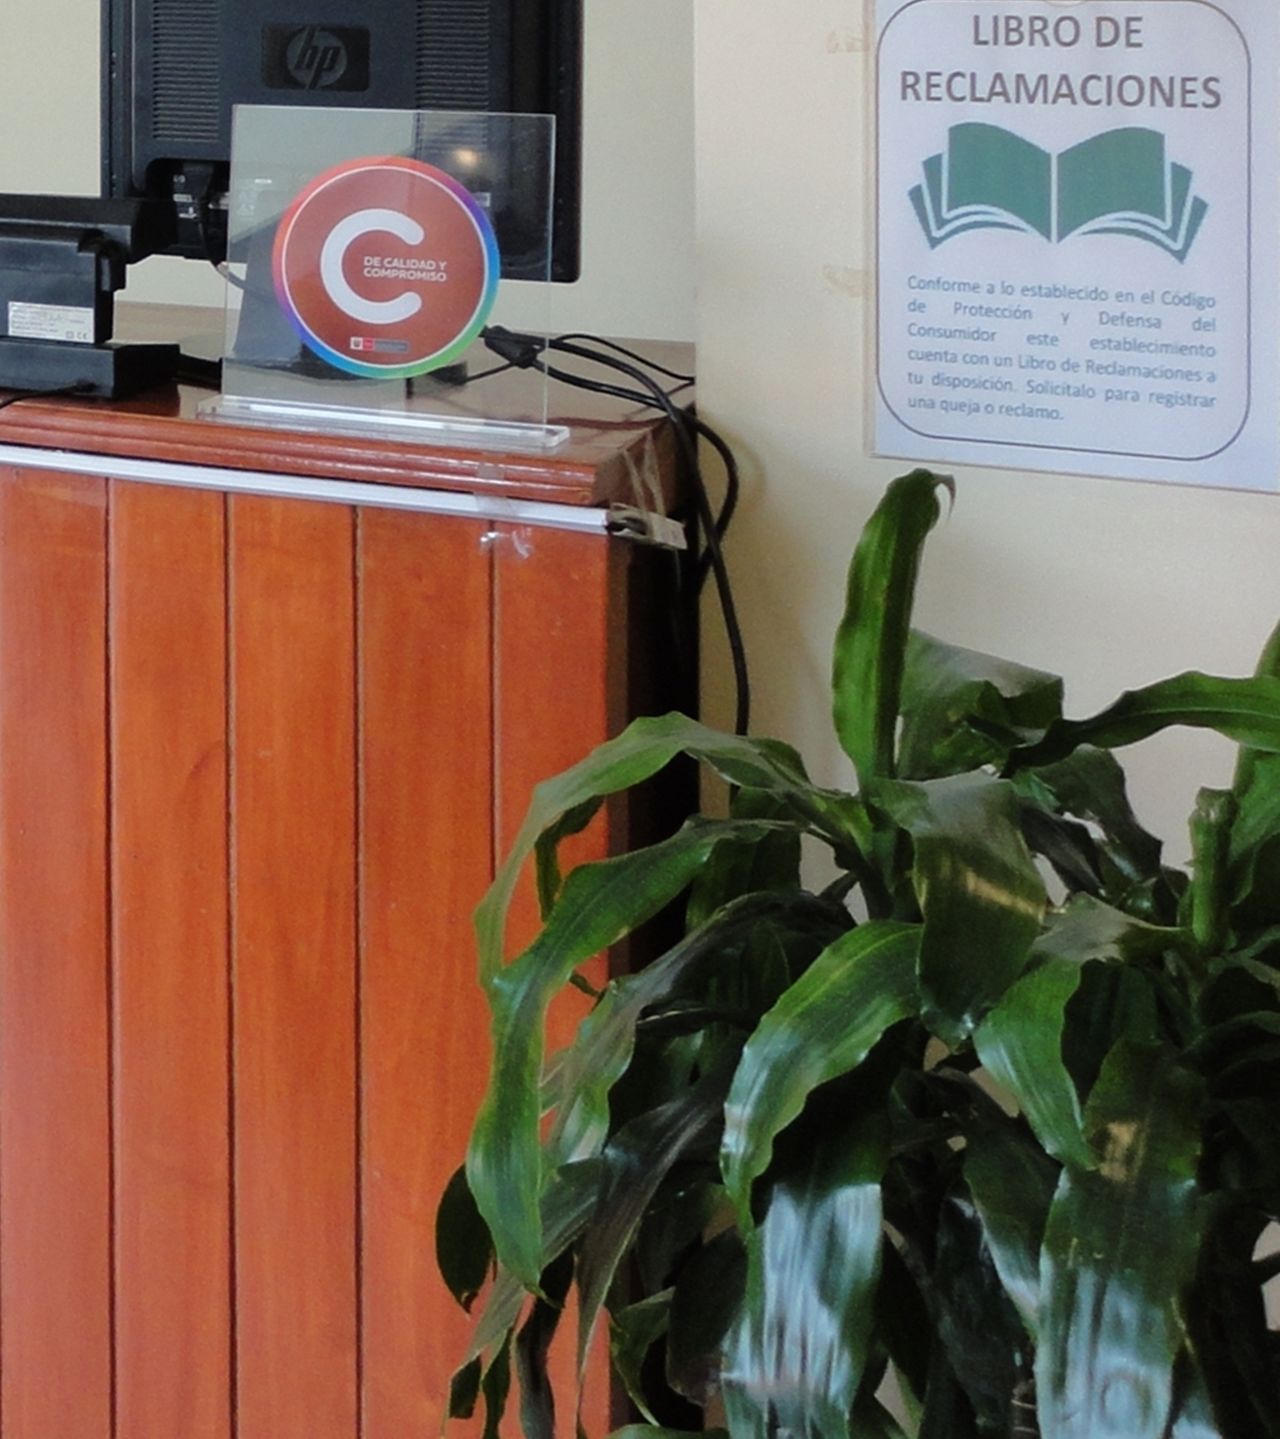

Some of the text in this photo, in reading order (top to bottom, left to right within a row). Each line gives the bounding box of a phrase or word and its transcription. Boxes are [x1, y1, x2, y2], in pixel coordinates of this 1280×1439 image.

[972, 15, 1144, 48] LIBRO DE
[293, 27, 342, 89] hp
[899, 70, 1222, 109] RECLAMACIONES
[320, 208, 425, 325] C
[363, 256, 448, 271] DE CALIDAD Y
[363, 267, 447, 282] COMPROMISO
[907, 275, 981, 294] Conforme
[986, 282, 996, 295] a
[1000, 281, 1015, 296] lo
[1020, 282, 1109, 303] establecido
[1114, 290, 1134, 303] en
[1141, 289, 1155, 304] el
[907, 299, 1217, 332] de Protección y Defensa del
[907, 322, 1217, 358] Consumidor este establecimiento
[907, 349, 1217, 383] cuenta con un Libro de Reclamaciones a
[907, 372, 924, 385] tu
[1104, 388, 1141, 404] para
[1148, 391, 1217, 409] registrar
[907, 396, 1064, 421] una queja o reclamo.
